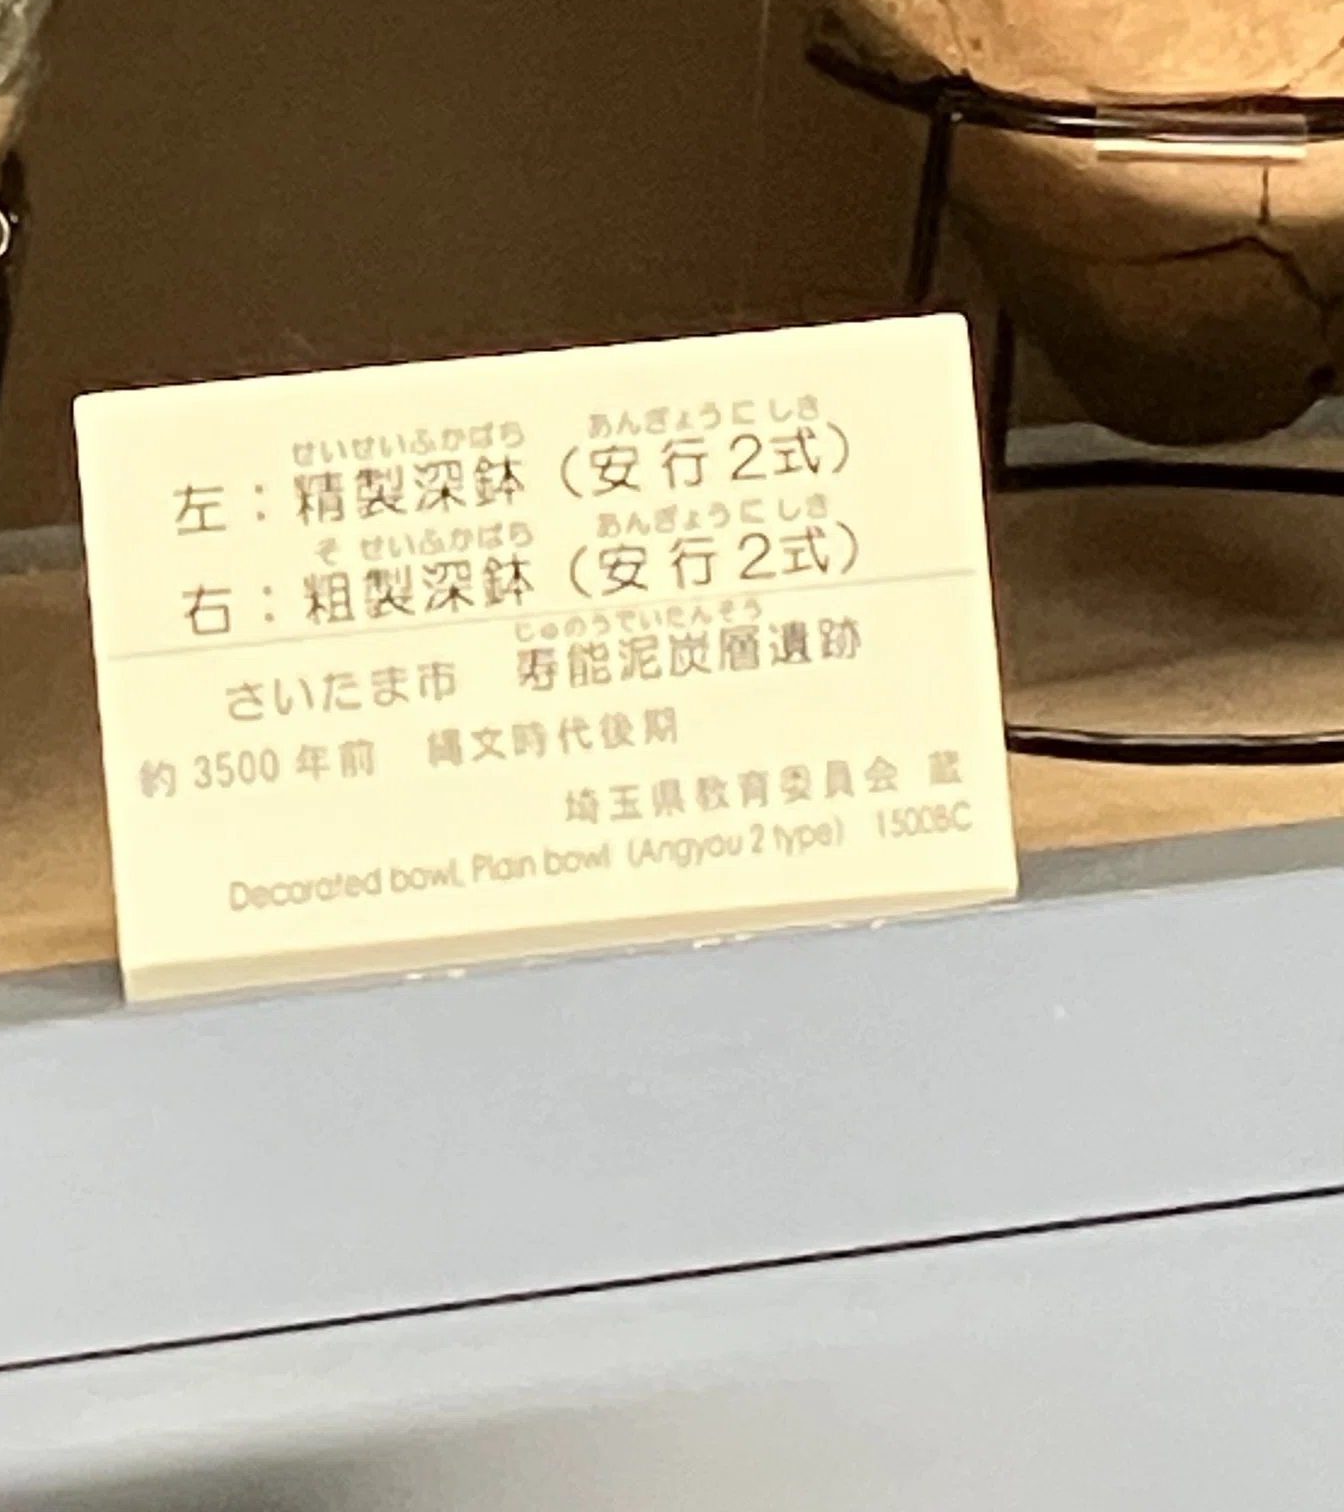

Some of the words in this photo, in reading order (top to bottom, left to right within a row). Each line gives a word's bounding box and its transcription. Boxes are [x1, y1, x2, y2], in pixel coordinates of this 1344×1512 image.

[225, 661, 457, 721] さいたま市
[516, 615, 862, 691] 寿能泥炭層遺跡
[427, 706, 679, 767] 縄文時代後期
[229, 866, 383, 911] Decorated
[471, 849, 537, 883] Plain
[543, 842, 611, 876] bowl
[627, 827, 744, 868] (Angyou
[750, 823, 765, 854] 2
[773, 816, 844, 855] type)
[876, 801, 974, 839] 1500BC
